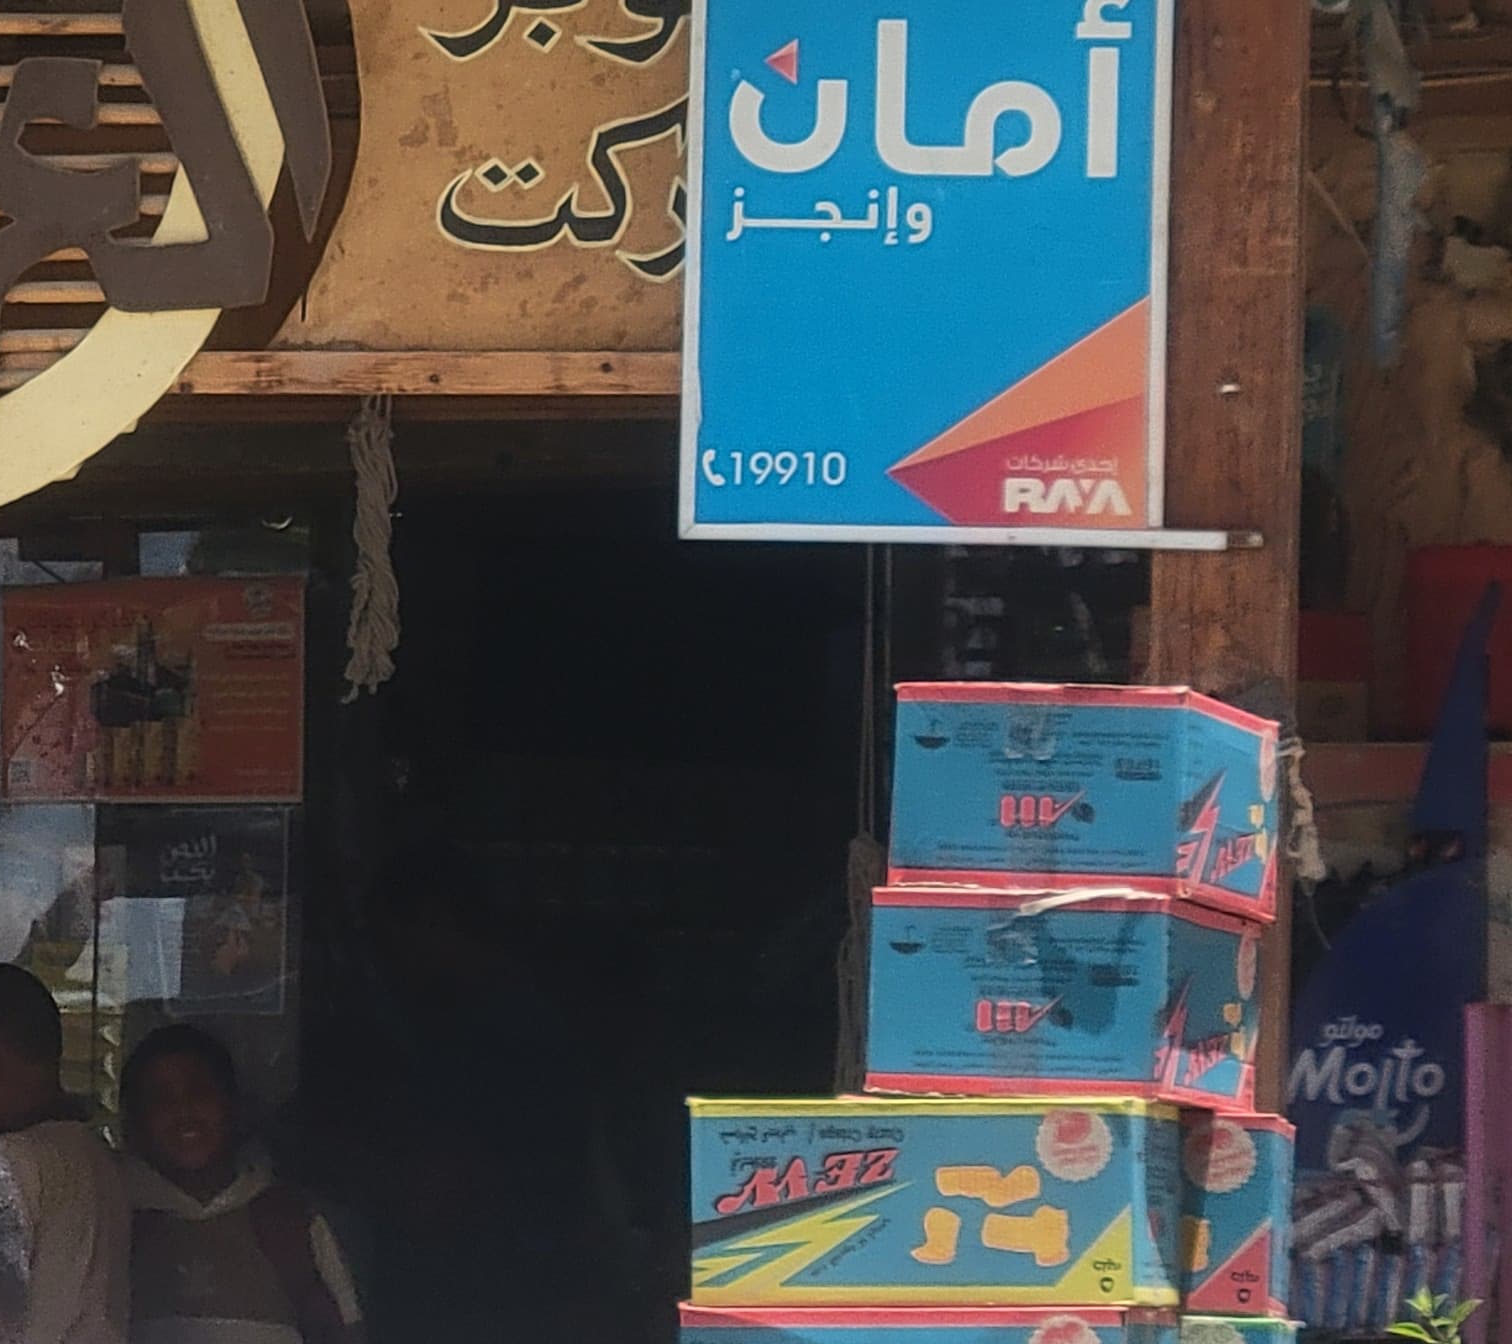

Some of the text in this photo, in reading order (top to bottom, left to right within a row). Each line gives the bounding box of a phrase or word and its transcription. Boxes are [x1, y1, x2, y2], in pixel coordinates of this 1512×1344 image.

[726, 186, 934, 247] وإنجز
[730, 450, 848, 488] 19910
[1003, 477, 1133, 517] RAYA
